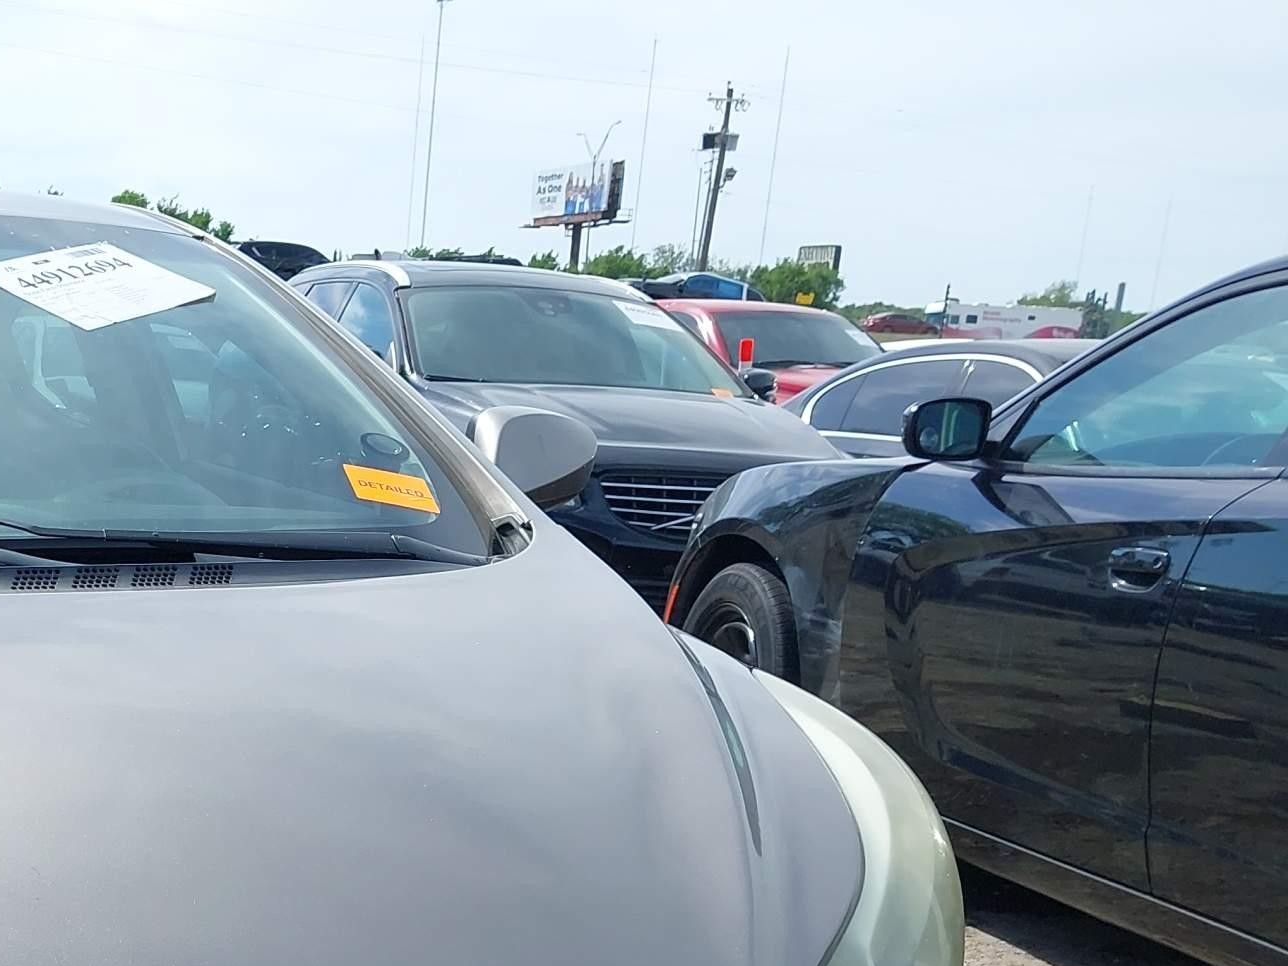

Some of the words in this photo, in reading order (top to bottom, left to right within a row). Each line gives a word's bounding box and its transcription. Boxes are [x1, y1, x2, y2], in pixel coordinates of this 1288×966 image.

[537, 173, 564, 184] Together
[536, 186, 546, 195] As
[547, 184, 562, 194] One
[16, 255, 133, 292] 44912694
[357, 479, 424, 497] DETAILED
